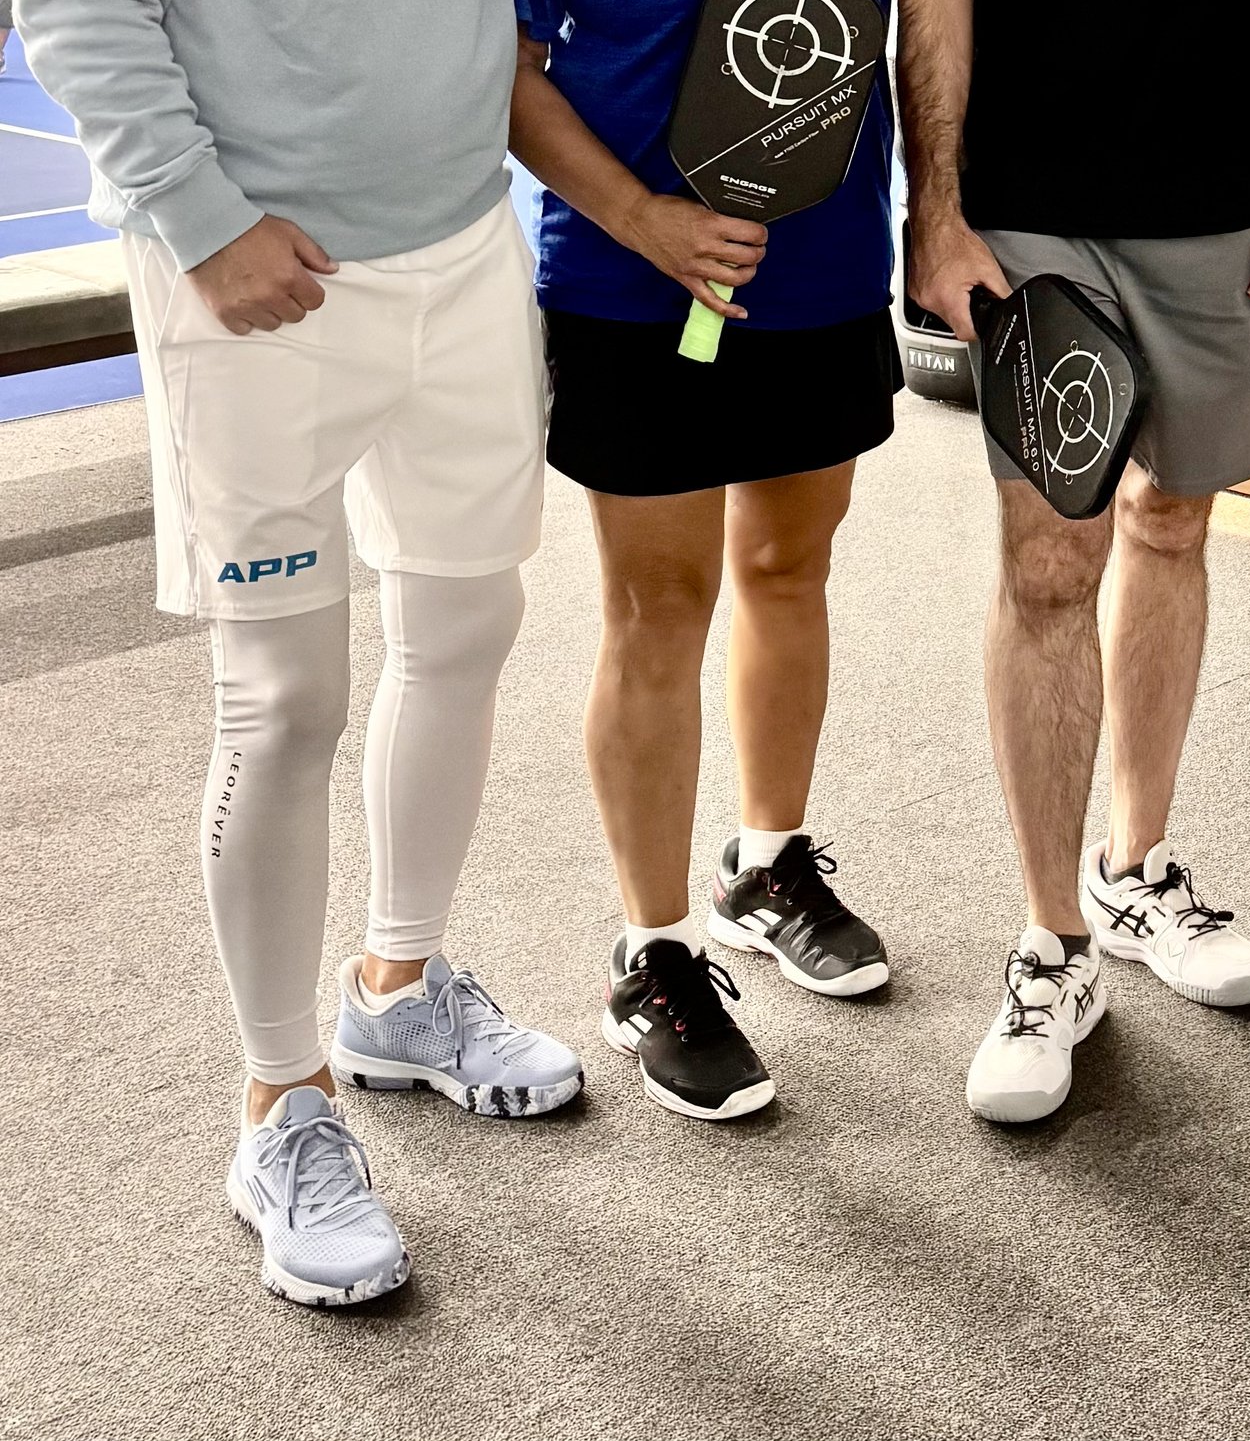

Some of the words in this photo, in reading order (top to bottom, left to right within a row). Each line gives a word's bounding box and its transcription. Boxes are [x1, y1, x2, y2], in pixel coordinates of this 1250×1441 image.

[760, 103, 828, 148] PURSUIT
[831, 84, 857, 106] MX
[820, 106, 852, 131] PRO
[719, 174, 778, 195] ENGAGE
[908, 349, 955, 372] TITAN
[1018, 340, 1034, 413] PURSUIT
[1027, 417, 1038, 445] MX
[1020, 426, 1030, 460] PRO
[217, 550, 318, 583] APP
